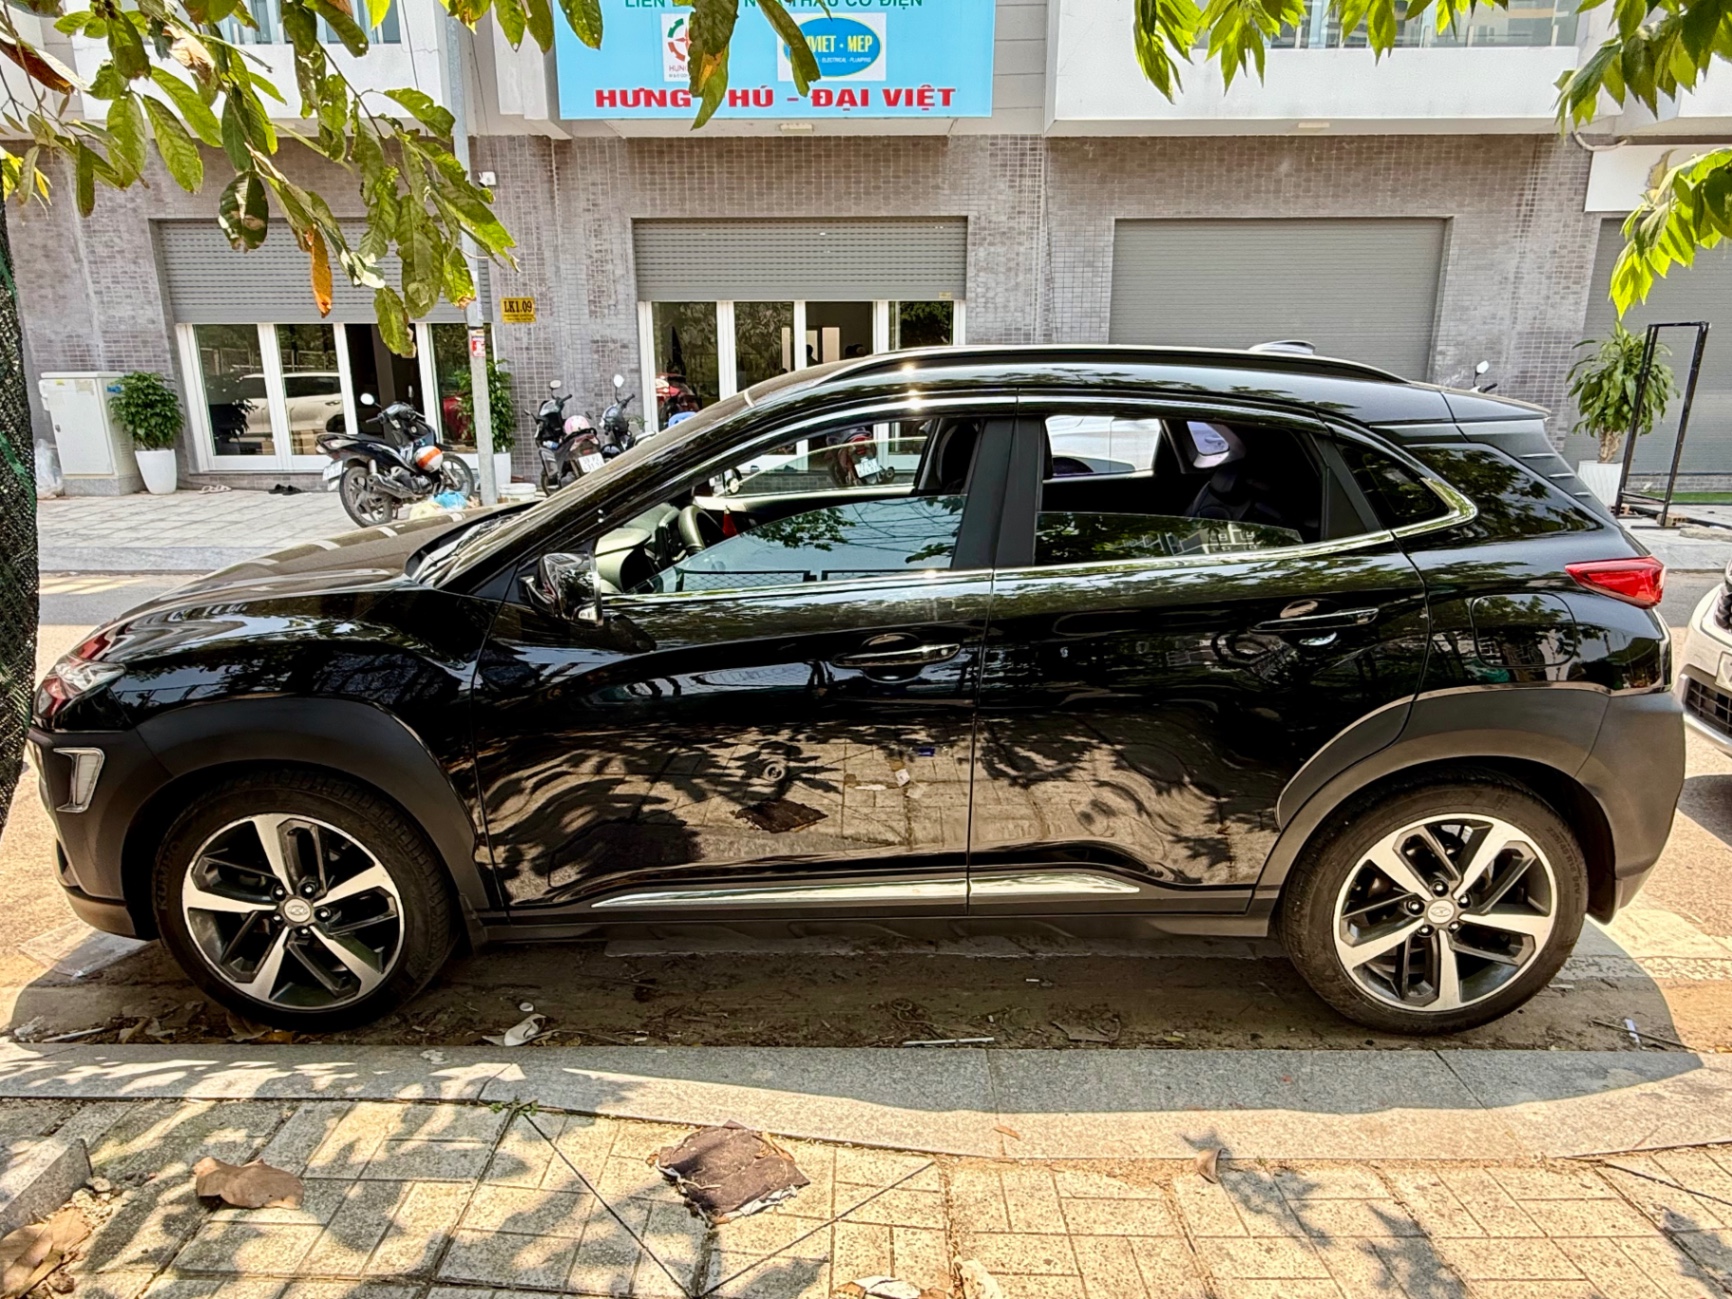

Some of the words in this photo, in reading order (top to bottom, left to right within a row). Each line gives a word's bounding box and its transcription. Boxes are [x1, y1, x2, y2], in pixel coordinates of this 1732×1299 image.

[847, 35, 873, 53] MEP
[595, 87, 692, 108] HƯNG
[728, 85, 774, 108] HÚ
[811, 88, 870, 111] ĐẠI
[883, 84, 956, 111] VIỆT
[503, 300, 533, 313] LK1.09
